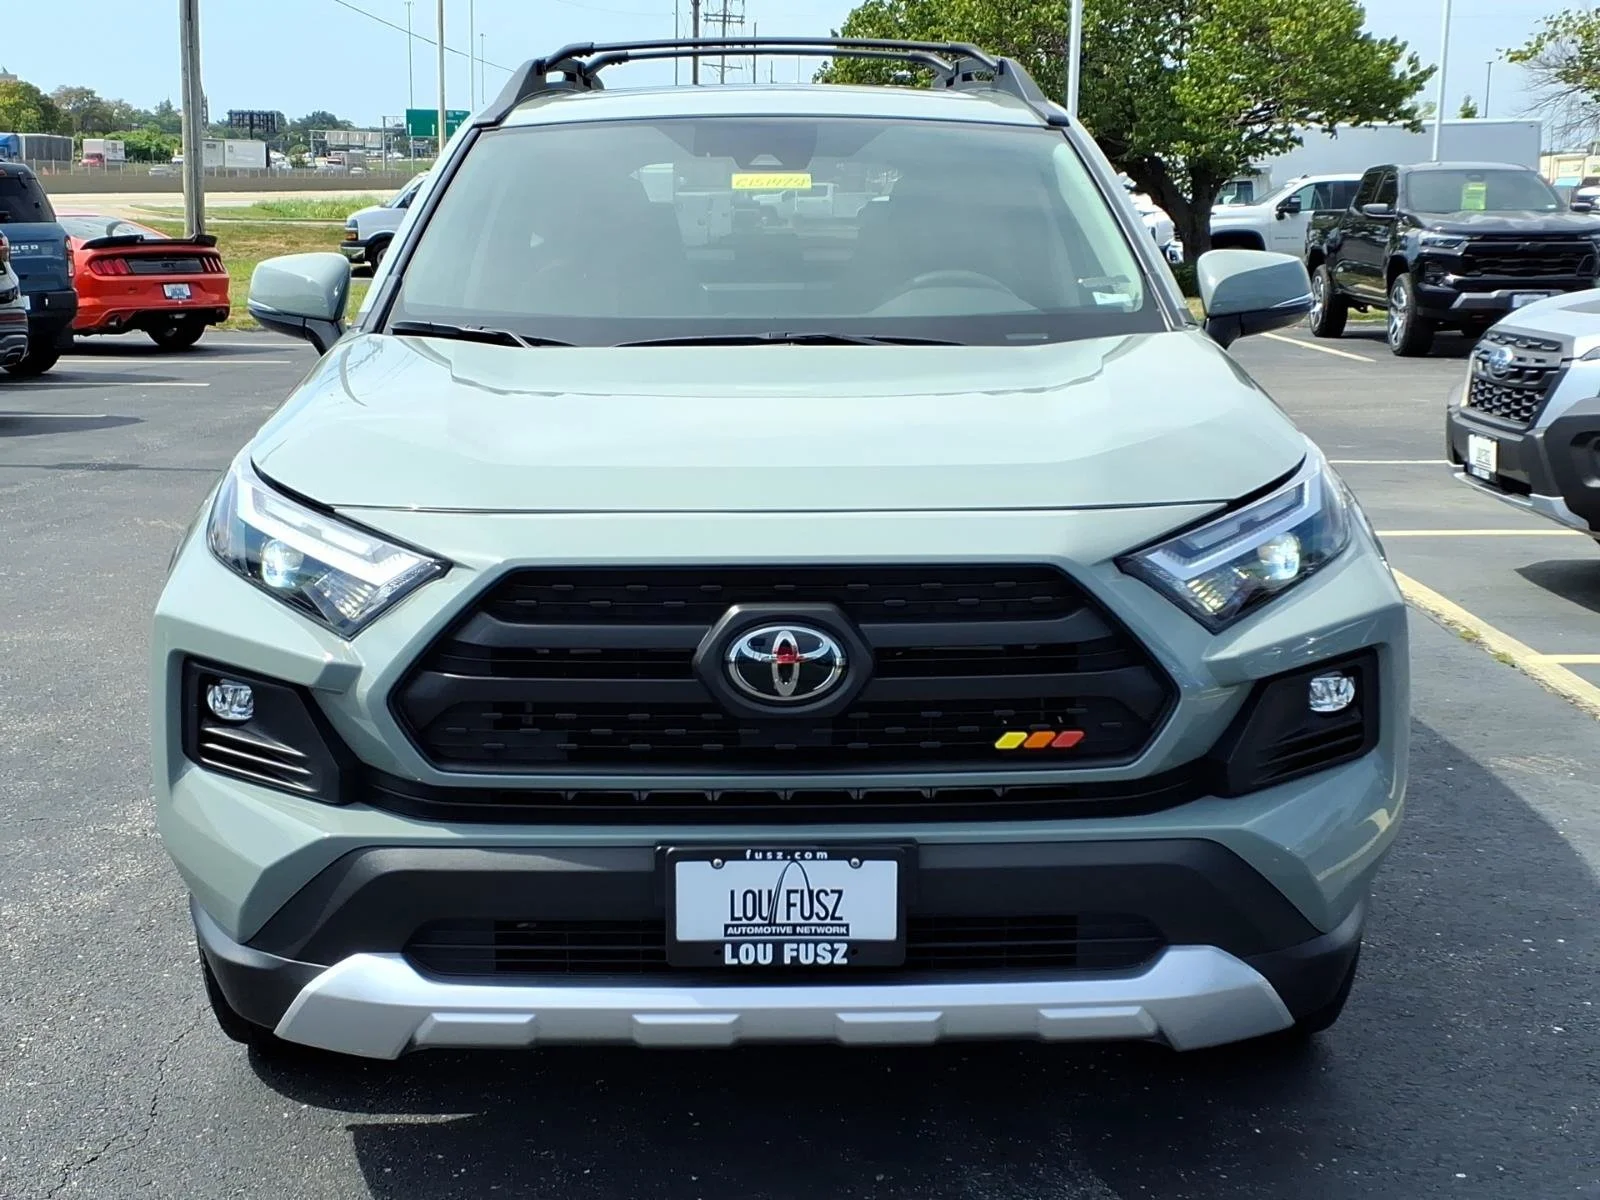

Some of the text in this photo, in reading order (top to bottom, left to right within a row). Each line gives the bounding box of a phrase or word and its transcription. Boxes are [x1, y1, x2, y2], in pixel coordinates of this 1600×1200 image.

[745, 849, 828, 860] fusz.com
[730, 889, 843, 921] LOU FUSZ
[727, 925, 848, 935] AUTOMOTIVE NETWORK
[724, 943, 848, 965] LOU FUSZ
